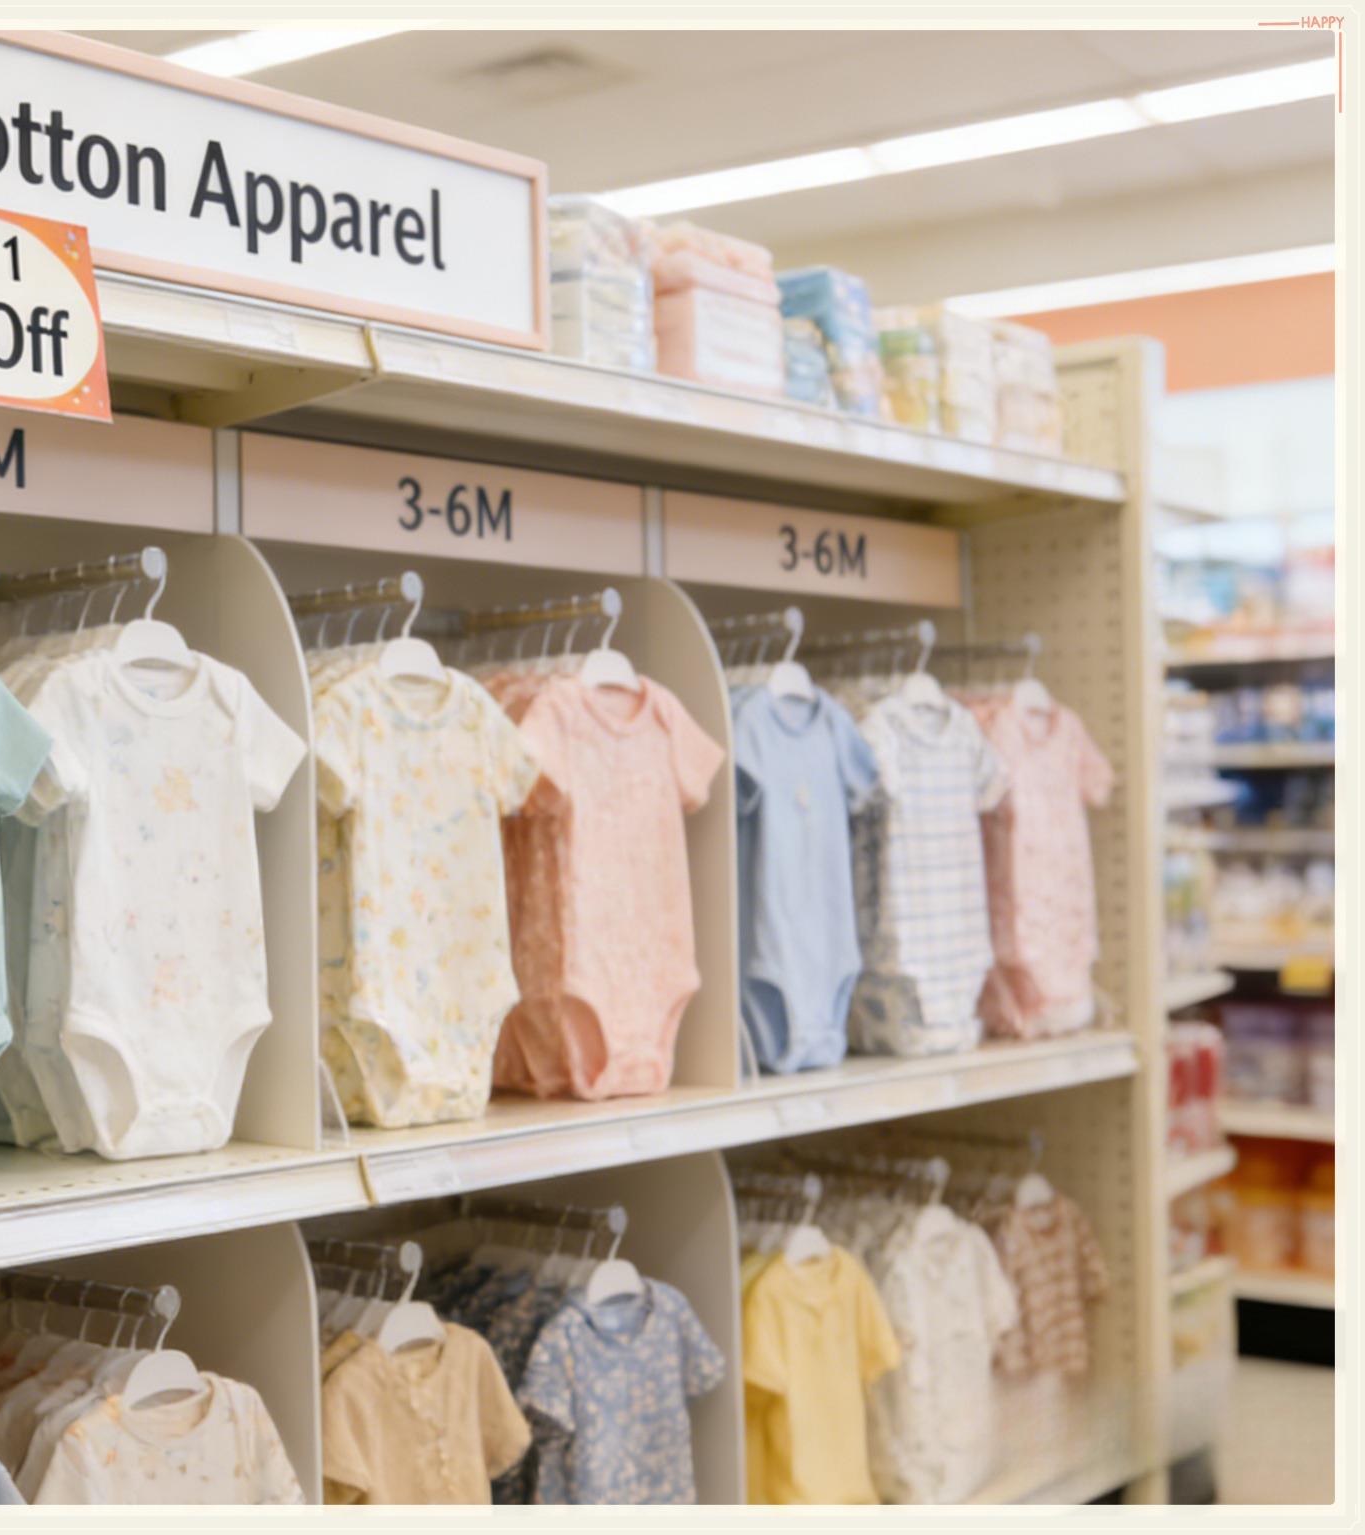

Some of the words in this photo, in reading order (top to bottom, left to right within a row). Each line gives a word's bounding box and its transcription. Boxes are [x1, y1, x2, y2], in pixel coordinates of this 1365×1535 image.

[189, 140, 446, 272] Apparel
[3, 235, 22, 282] 1
[397, 476, 513, 541] 3-6M
[777, 523, 868, 578] 3-6M
